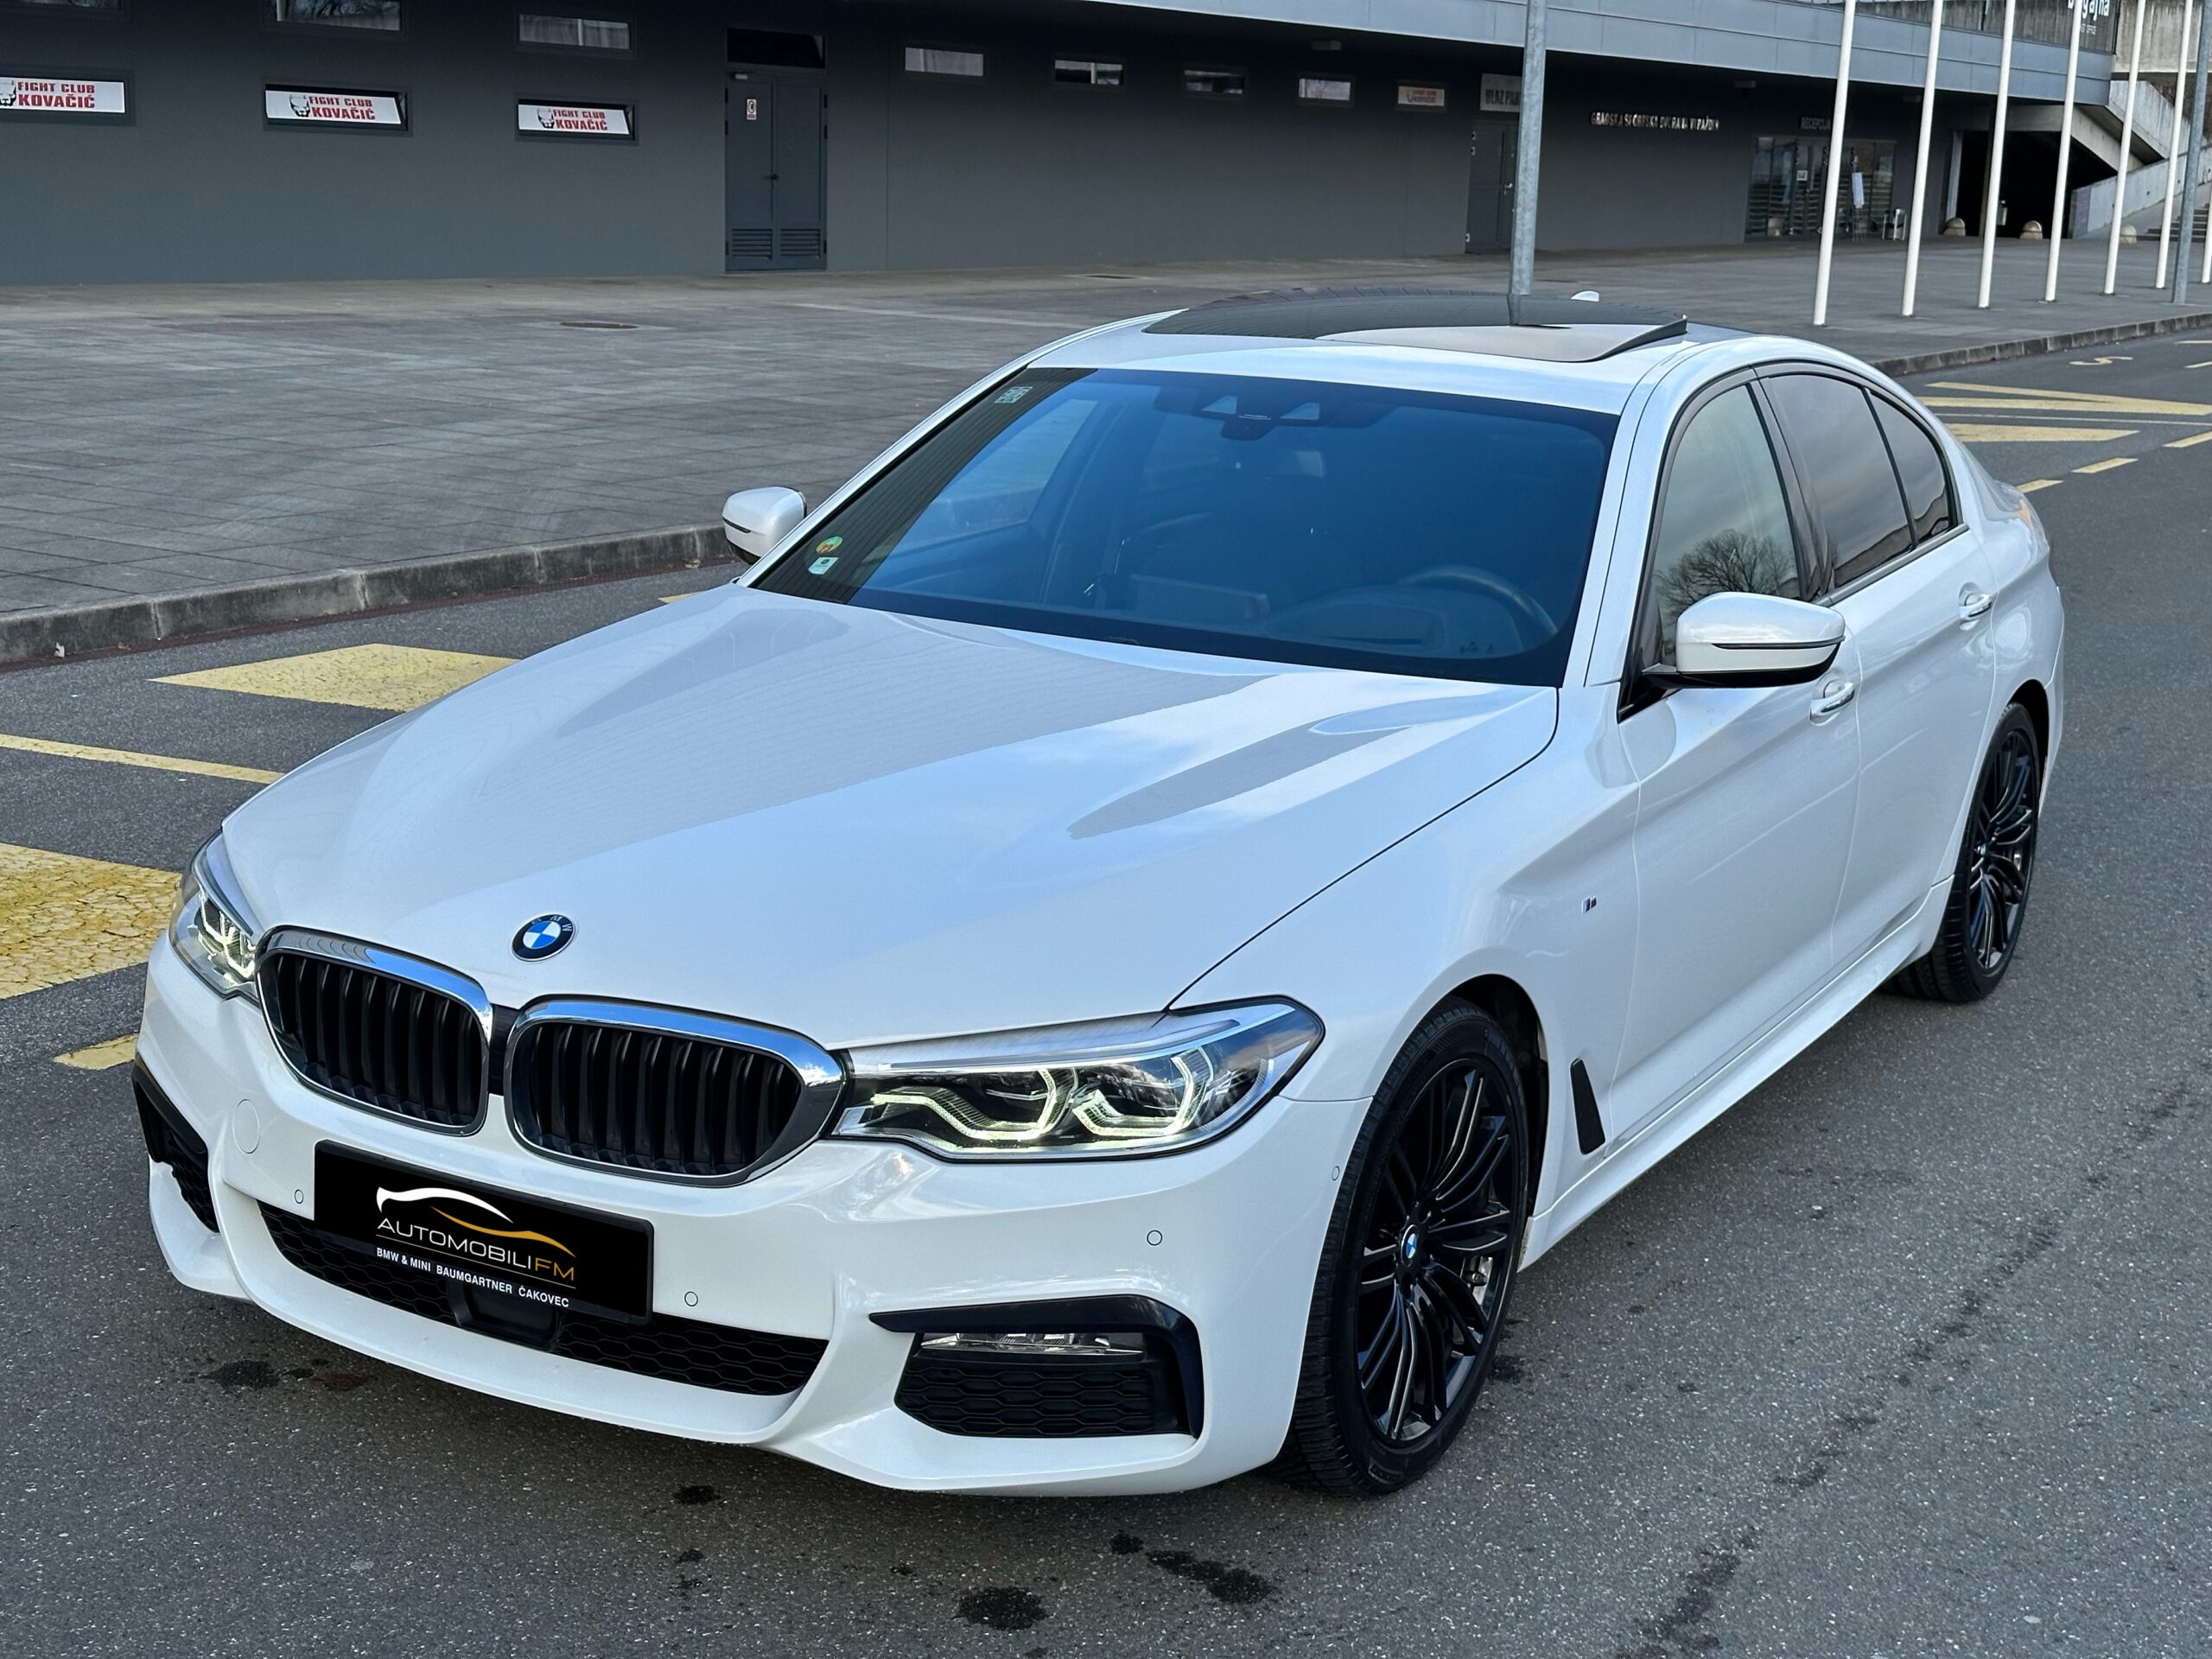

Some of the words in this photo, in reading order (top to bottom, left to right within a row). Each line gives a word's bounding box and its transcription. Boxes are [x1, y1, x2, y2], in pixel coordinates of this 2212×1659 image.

[17, 81, 55, 92] FIGHT
[61, 84, 95, 93] CLUB
[18, 93, 95, 109] KOVAČIĆ
[308, 96, 340, 105] FIGHT
[344, 98, 372, 107] CLUB
[311, 106, 375, 120] KOVAČIĆ
[553, 109, 579, 118] FIGHT
[582, 111, 606, 119] CLUB
[377, 1247, 399, 1262] BMW
[401, 1255, 408, 1265] &
[410, 1257, 431, 1272] MINI
[436, 1265, 512, 1294] BAUMGARTNER
[518, 1285, 569, 1308] ČAKOVEC
